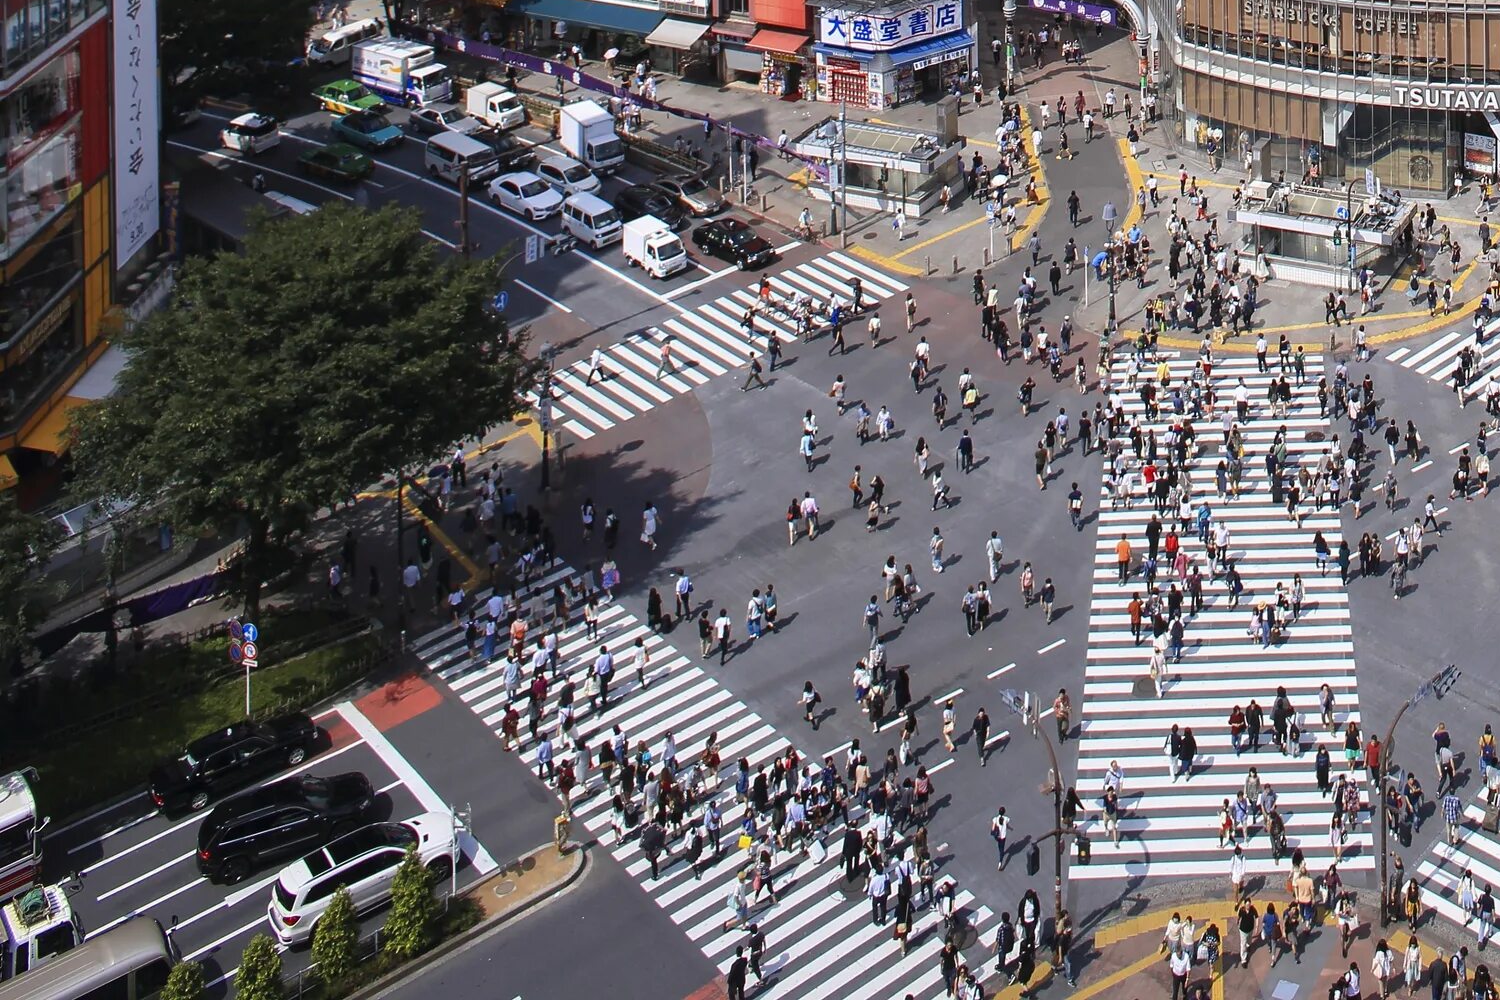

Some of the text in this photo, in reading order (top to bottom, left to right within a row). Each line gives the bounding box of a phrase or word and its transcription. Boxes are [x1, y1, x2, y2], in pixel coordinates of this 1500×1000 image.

[827, 3, 956, 42] 大盛堂書店
[1244, 0, 1419, 37] STARBUCKS COFFEE
[1395, 86, 1500, 111] TSUTAYA
